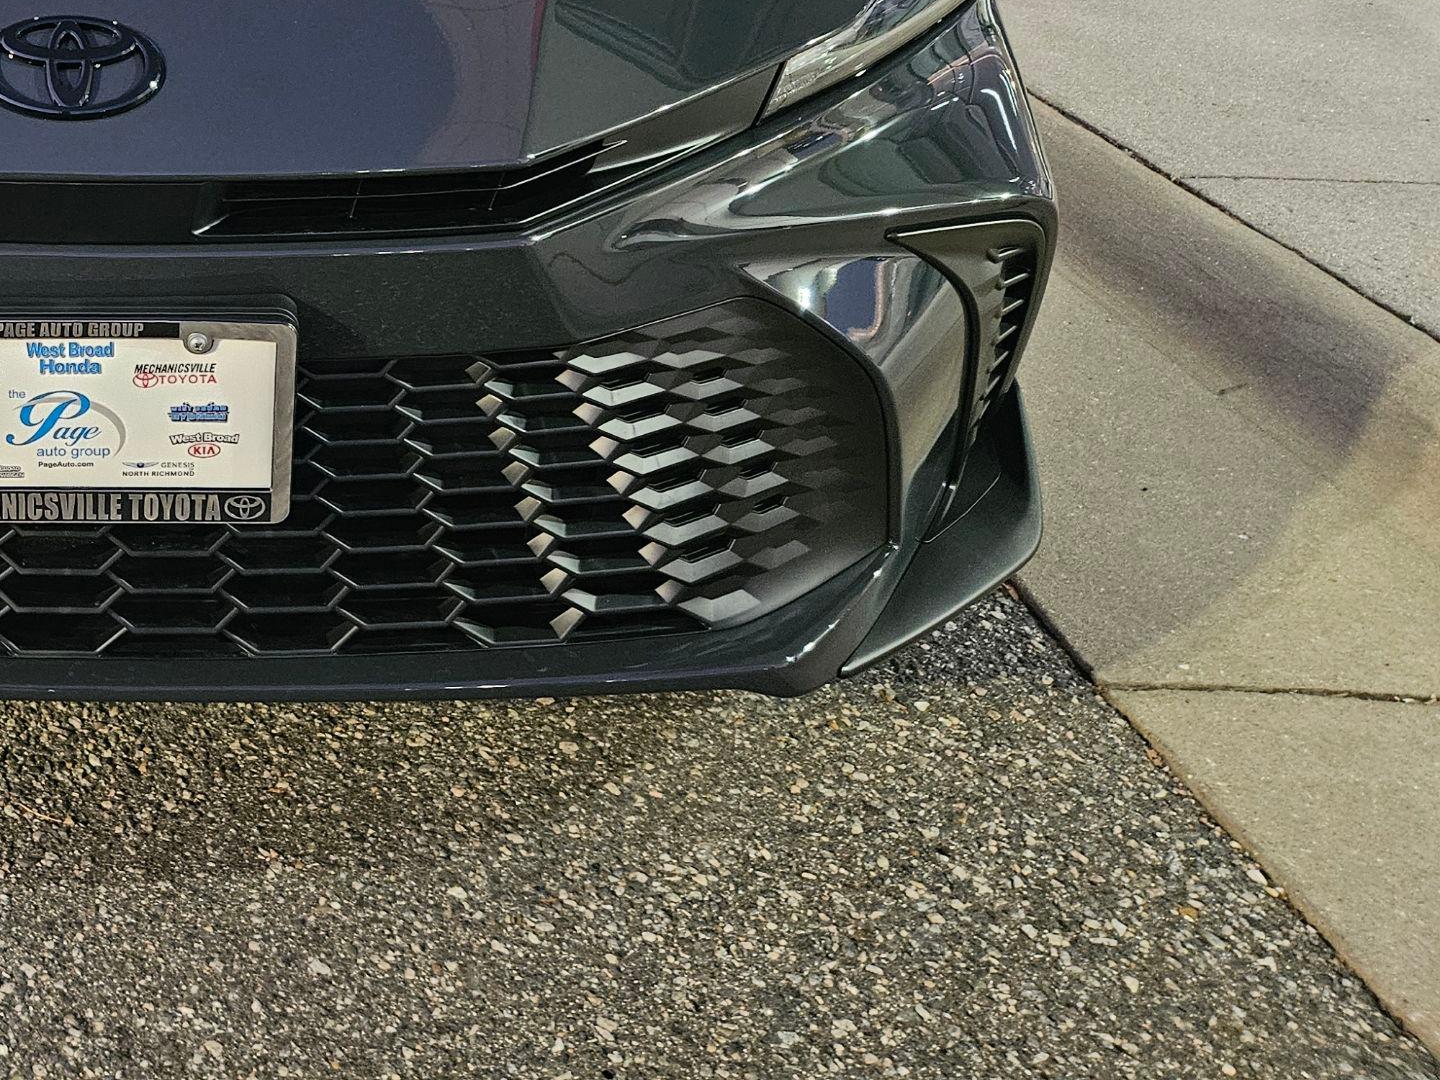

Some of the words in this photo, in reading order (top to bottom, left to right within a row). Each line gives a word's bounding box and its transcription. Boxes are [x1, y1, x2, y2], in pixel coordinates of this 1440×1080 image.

[38, 322, 84, 338] AUTO
[87, 322, 145, 338] GROUP
[26, 341, 66, 359] West
[68, 341, 115, 358] Broad
[39, 358, 102, 375] Honda
[134, 363, 217, 374] MECHANICSVILLE
[159, 374, 218, 384] TOYOTA
[8, 389, 26, 399] the
[5, 390, 101, 447] Page
[169, 434, 202, 445] West
[203, 432, 240, 444] Broad
[36, 446, 67, 457] auto
[71, 447, 111, 460] group
[192, 446, 216, 456] KIA
[38, 461, 94, 469] PageAuto.com
[160, 461, 195, 469] GENESIS
[128, 493, 222, 521] TOYOTA
